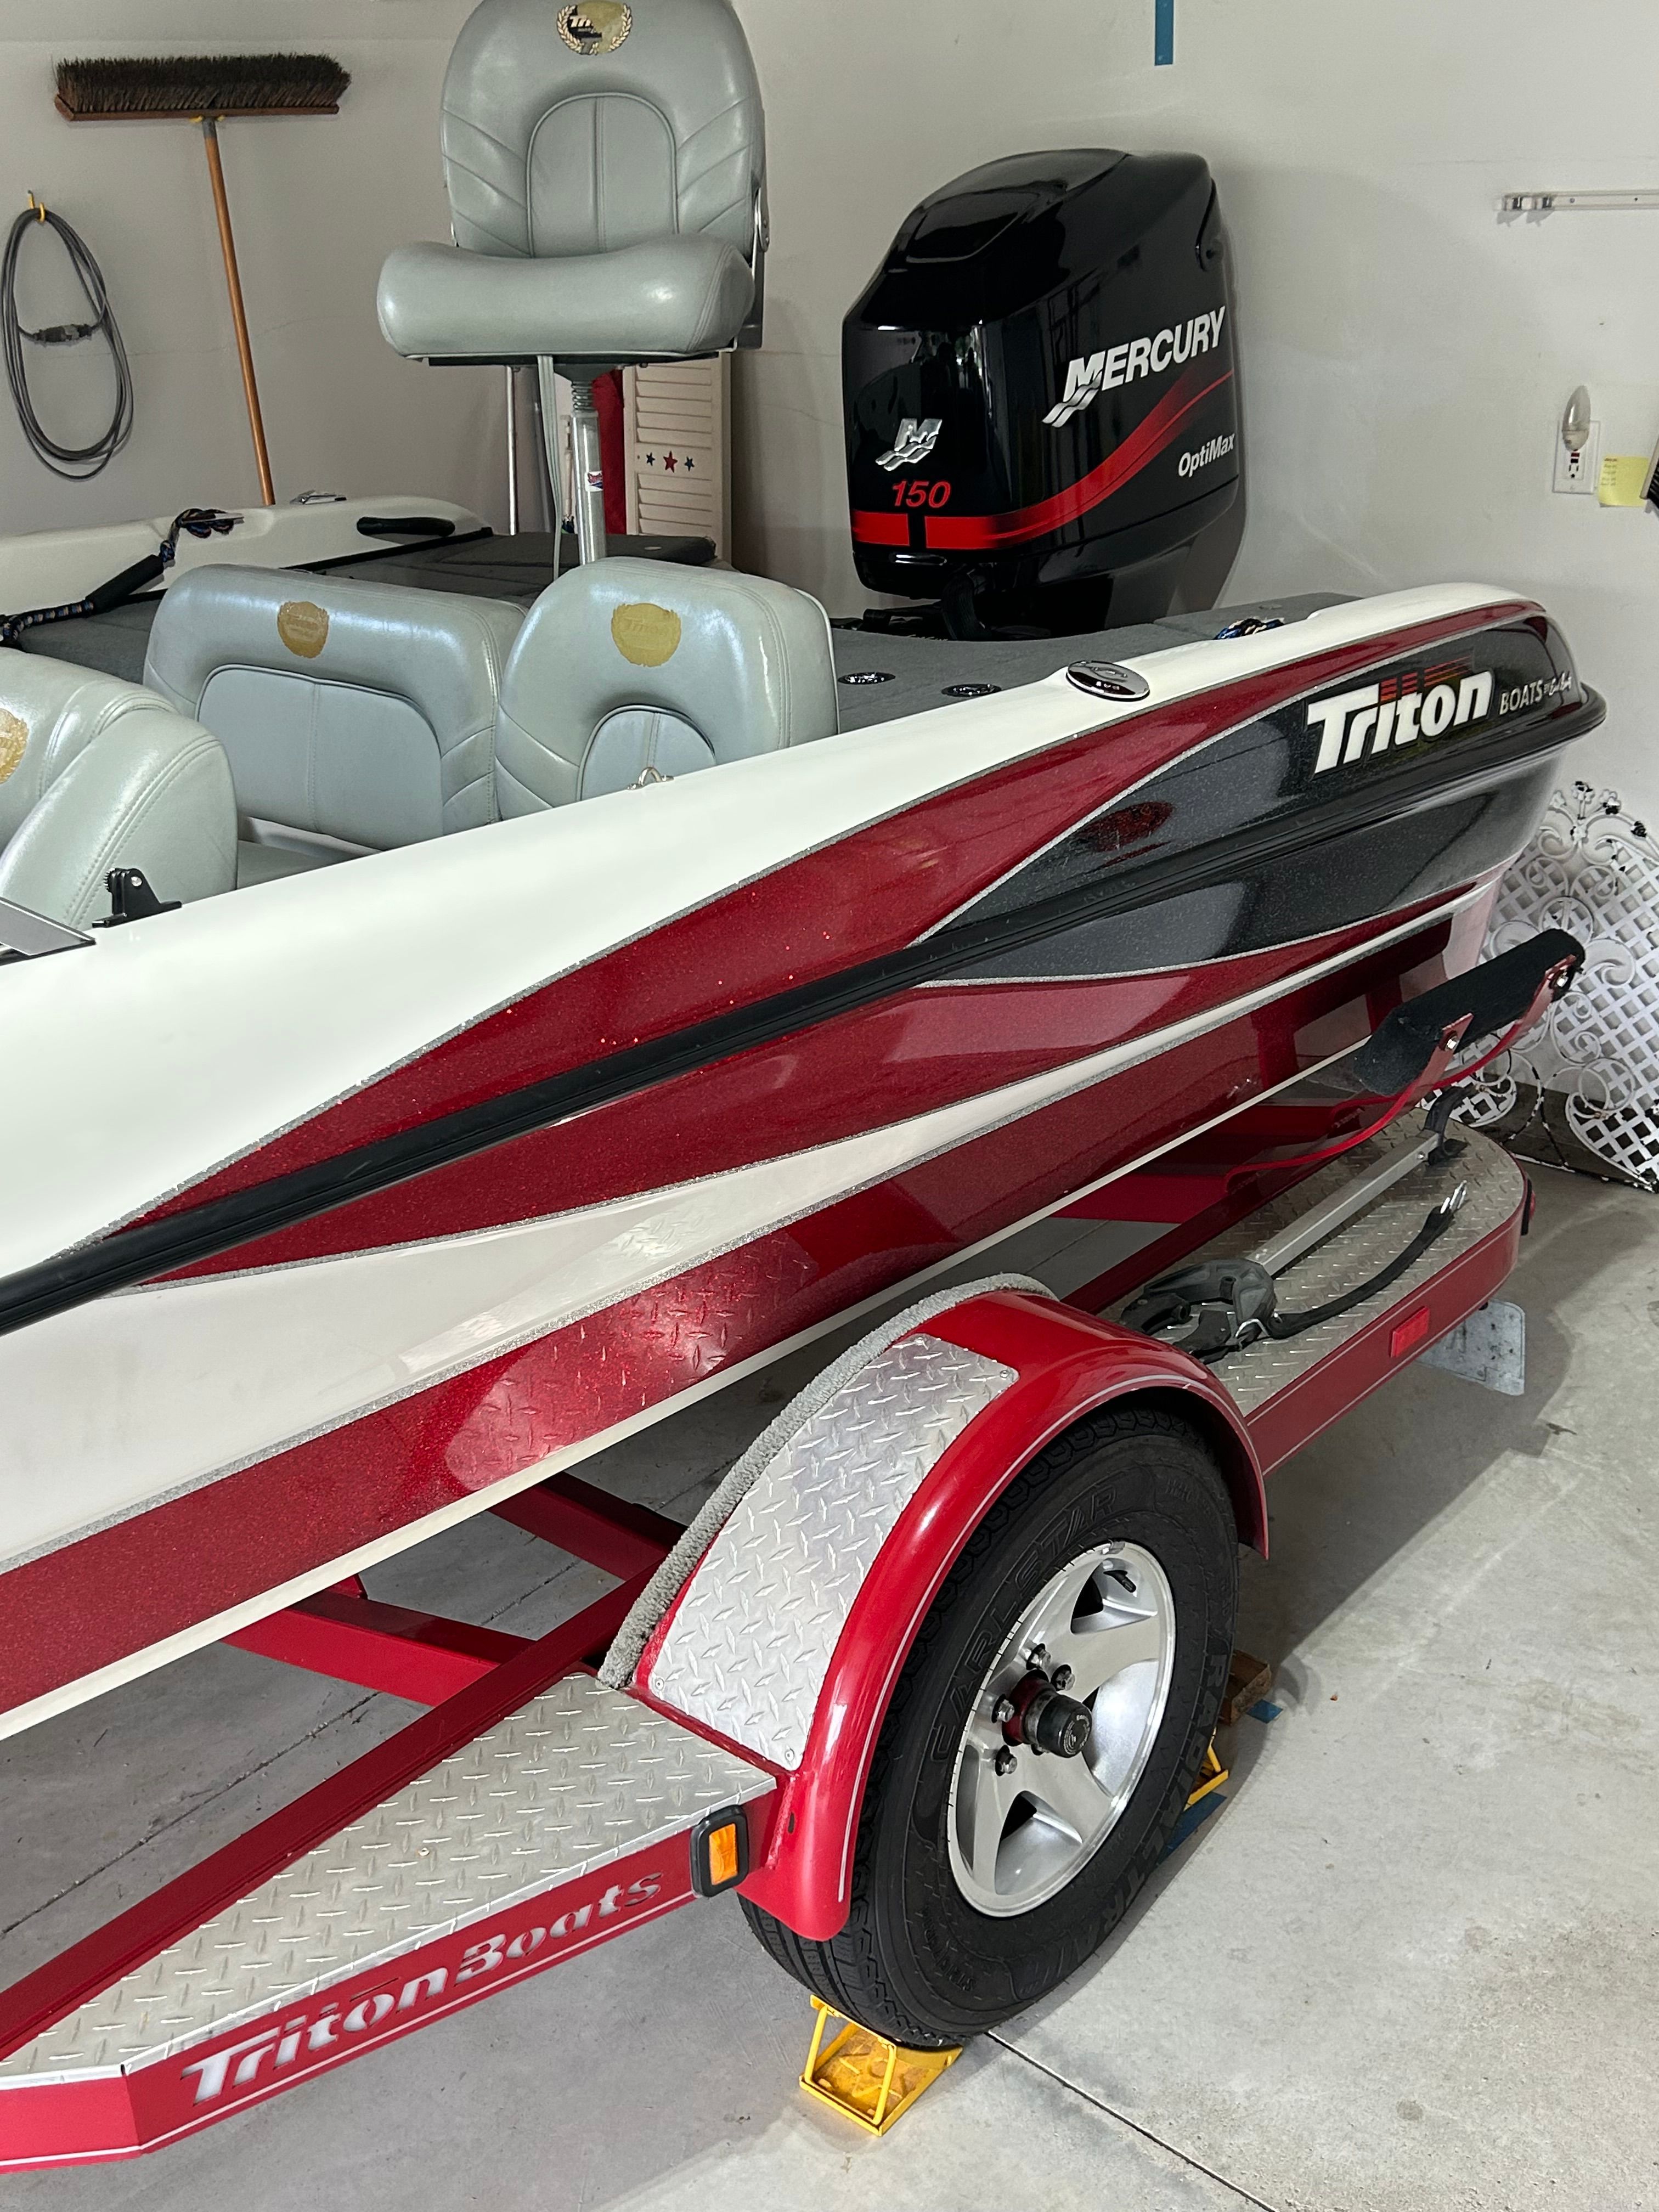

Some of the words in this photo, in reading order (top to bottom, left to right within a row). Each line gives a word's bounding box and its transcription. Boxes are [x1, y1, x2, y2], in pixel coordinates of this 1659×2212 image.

[1062, 306, 1226, 403] MERCURY
[892, 479, 951, 509] 150
[1178, 433, 1235, 478] OptiMax
[1307, 670, 1493, 774] Triton
[1499, 679, 1543, 715] BOATS
[930, 1483, 1117, 1762] CARLSTAR
[180, 1967, 448, 2106] Triton
[454, 1872, 662, 1984] Boats
